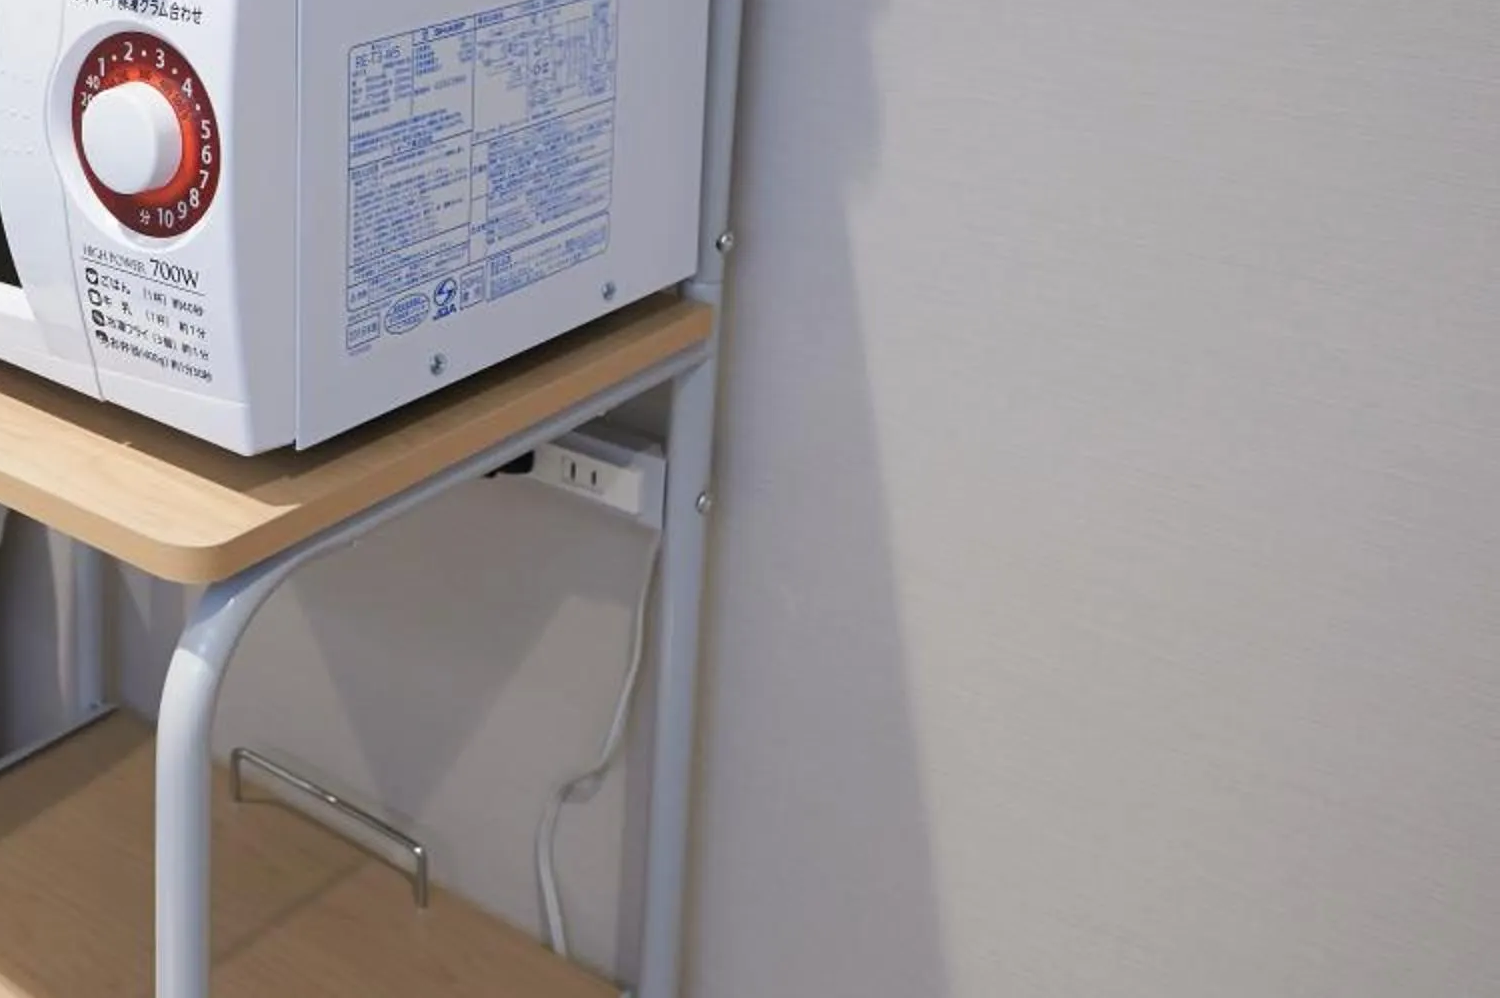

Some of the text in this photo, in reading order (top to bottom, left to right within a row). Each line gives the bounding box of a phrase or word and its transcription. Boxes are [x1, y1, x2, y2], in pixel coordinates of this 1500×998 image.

[123, 41, 133, 62] 2
[155, 48, 165, 69] 3
[98, 57, 105, 77] 1
[182, 78, 193, 98] 4
[201, 119, 211, 139] 5
[201, 144, 212, 164] 6
[199, 169, 209, 189] 7
[189, 188, 200, 208] 8
[157, 206, 175, 228] 10
[177, 201, 188, 220] 9
[150, 258, 200, 288] 700W
